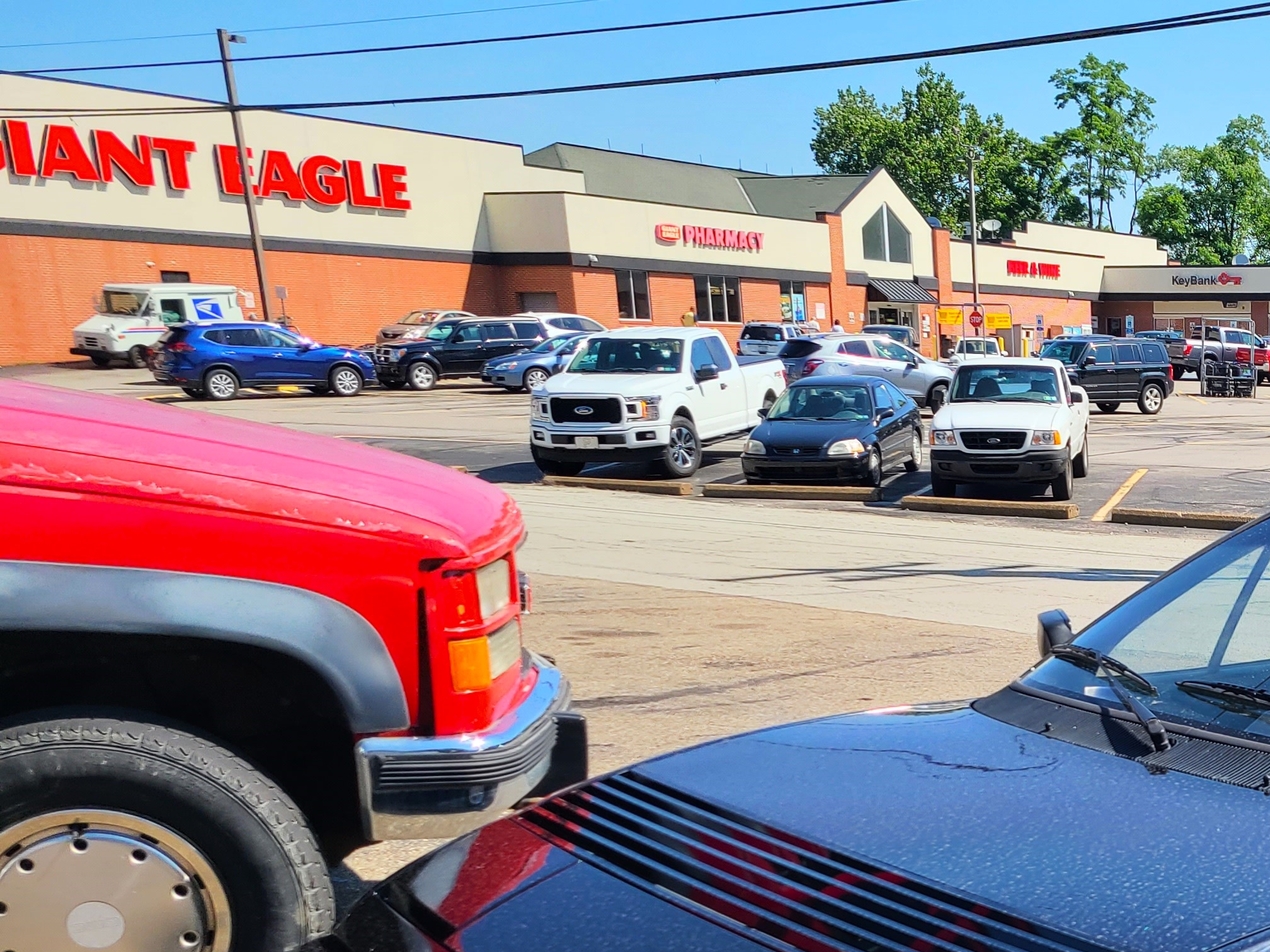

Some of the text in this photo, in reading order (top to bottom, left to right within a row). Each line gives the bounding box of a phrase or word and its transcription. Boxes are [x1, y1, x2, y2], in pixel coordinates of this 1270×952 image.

[0, 119, 412, 210] IANT EAGLE
[683, 225, 764, 250] PHARMACY
[1172, 275, 1217, 287] KeyBank
